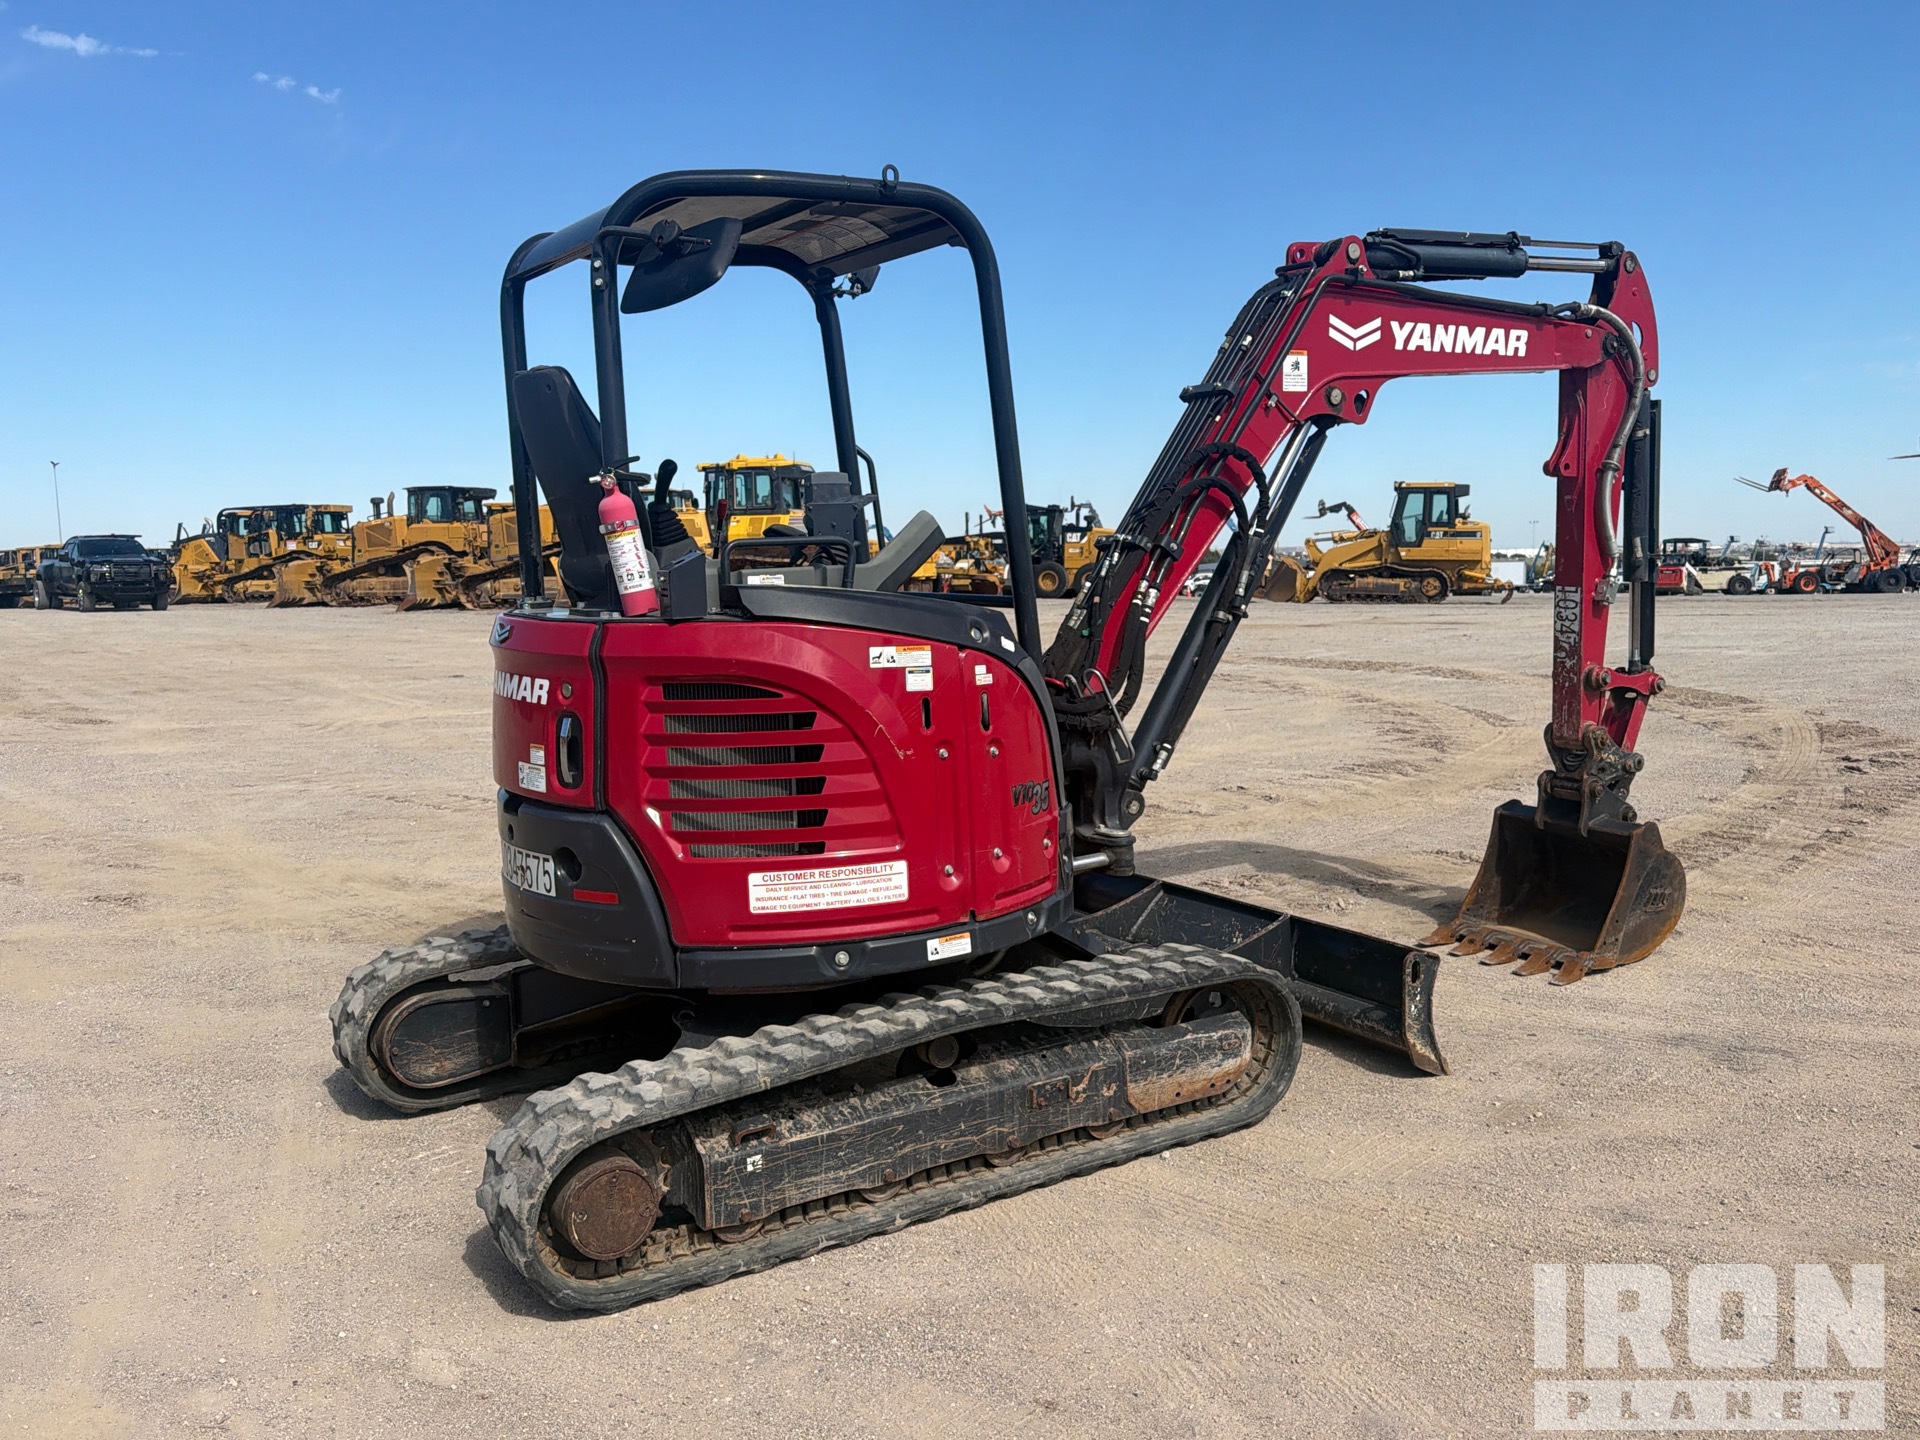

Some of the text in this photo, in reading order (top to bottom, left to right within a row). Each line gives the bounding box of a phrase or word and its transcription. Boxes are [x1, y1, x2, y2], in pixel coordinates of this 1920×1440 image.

[1390, 320, 1528, 357] YANMAR
[1066, 532, 1081, 543] CAT
[1430, 531, 1444, 539] CAT
[762, 864, 894, 882] CUSTOMER RESPONSIBILITY
[856, 877, 892, 886] LUBRICATION
[872, 885, 903, 893] REFUELING
